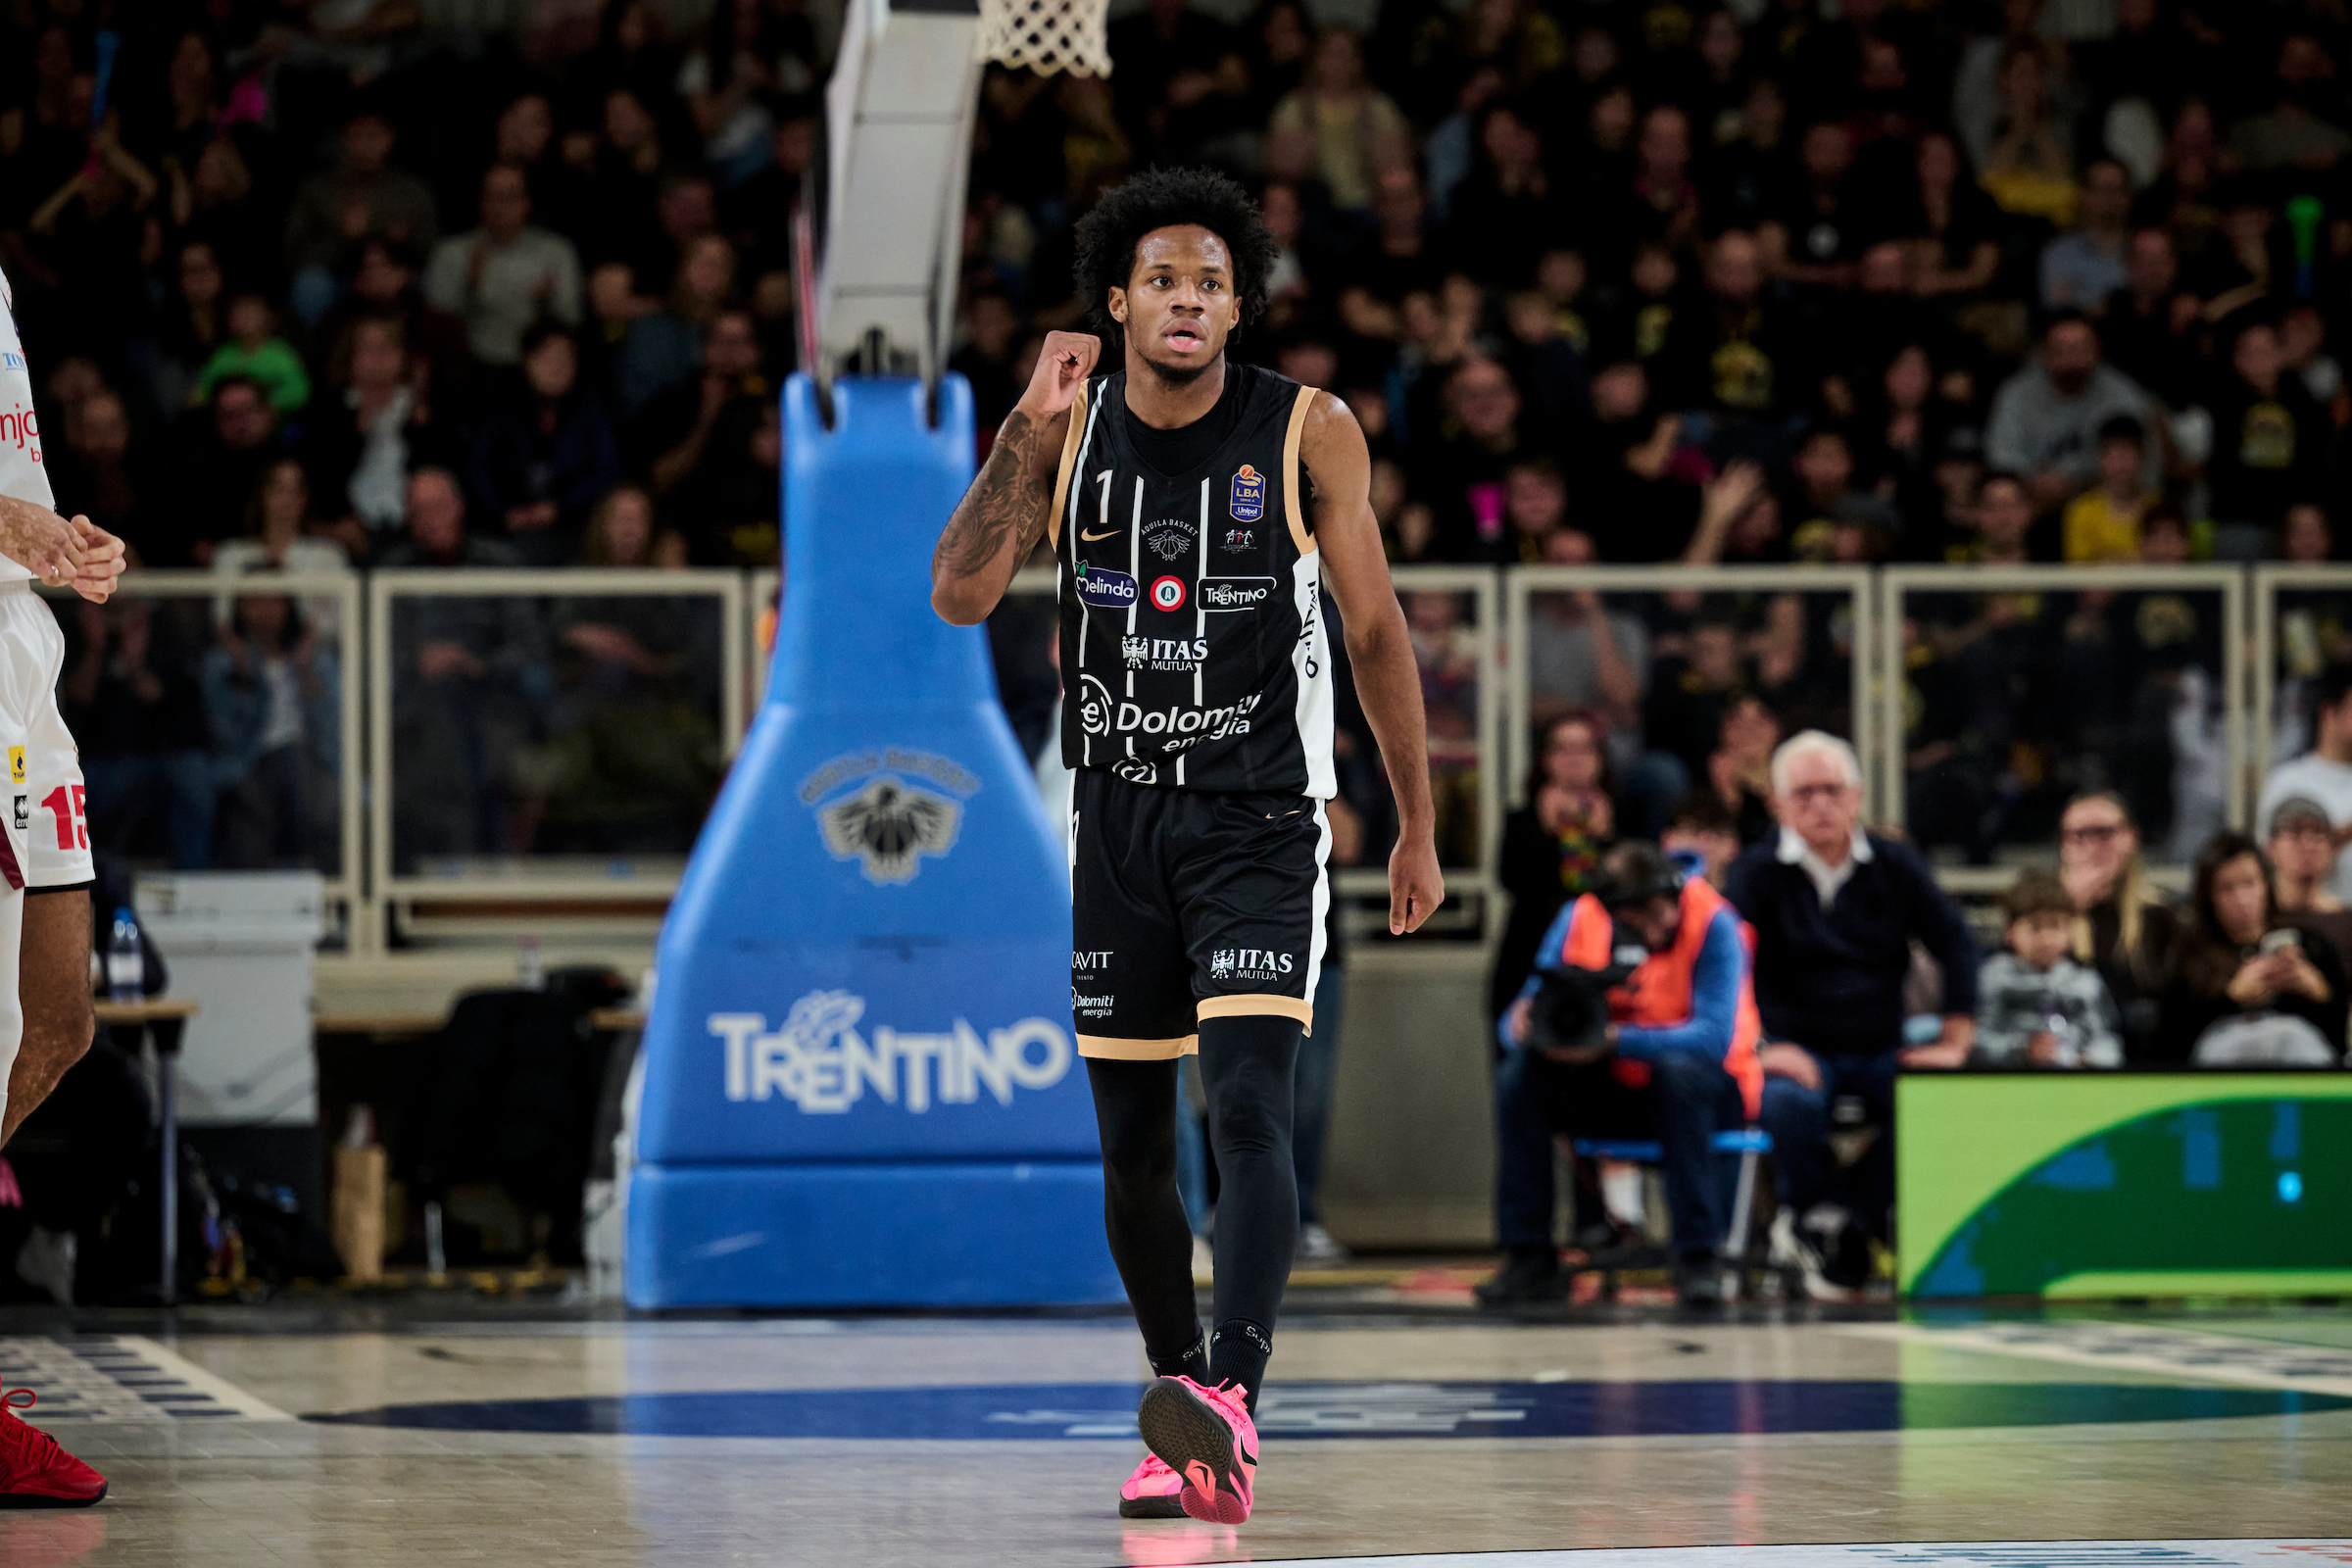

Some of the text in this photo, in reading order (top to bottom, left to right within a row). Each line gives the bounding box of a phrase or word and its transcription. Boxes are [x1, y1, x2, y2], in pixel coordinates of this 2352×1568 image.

[1096, 468, 1113, 523] 1
[1236, 487, 1260, 498] LBA
[1238, 507, 1257, 516] Unipol
[1141, 518, 1199, 536] AQUILA BASKET
[1076, 576, 1134, 599] Melinda
[1205, 587, 1267, 605] TRENTINO
[1152, 639, 1208, 661] ITAS
[1152, 661, 1194, 671] MUTUA
[1072, 951, 1114, 970] CAVIT
[1238, 949, 1293, 973] ITAS
[1236, 969, 1278, 981] MUTUA
[1077, 995, 1114, 1006] Dolomiti
[1083, 1007, 1112, 1018] energia
[708, 1009, 1071, 1113] TRENTINO
